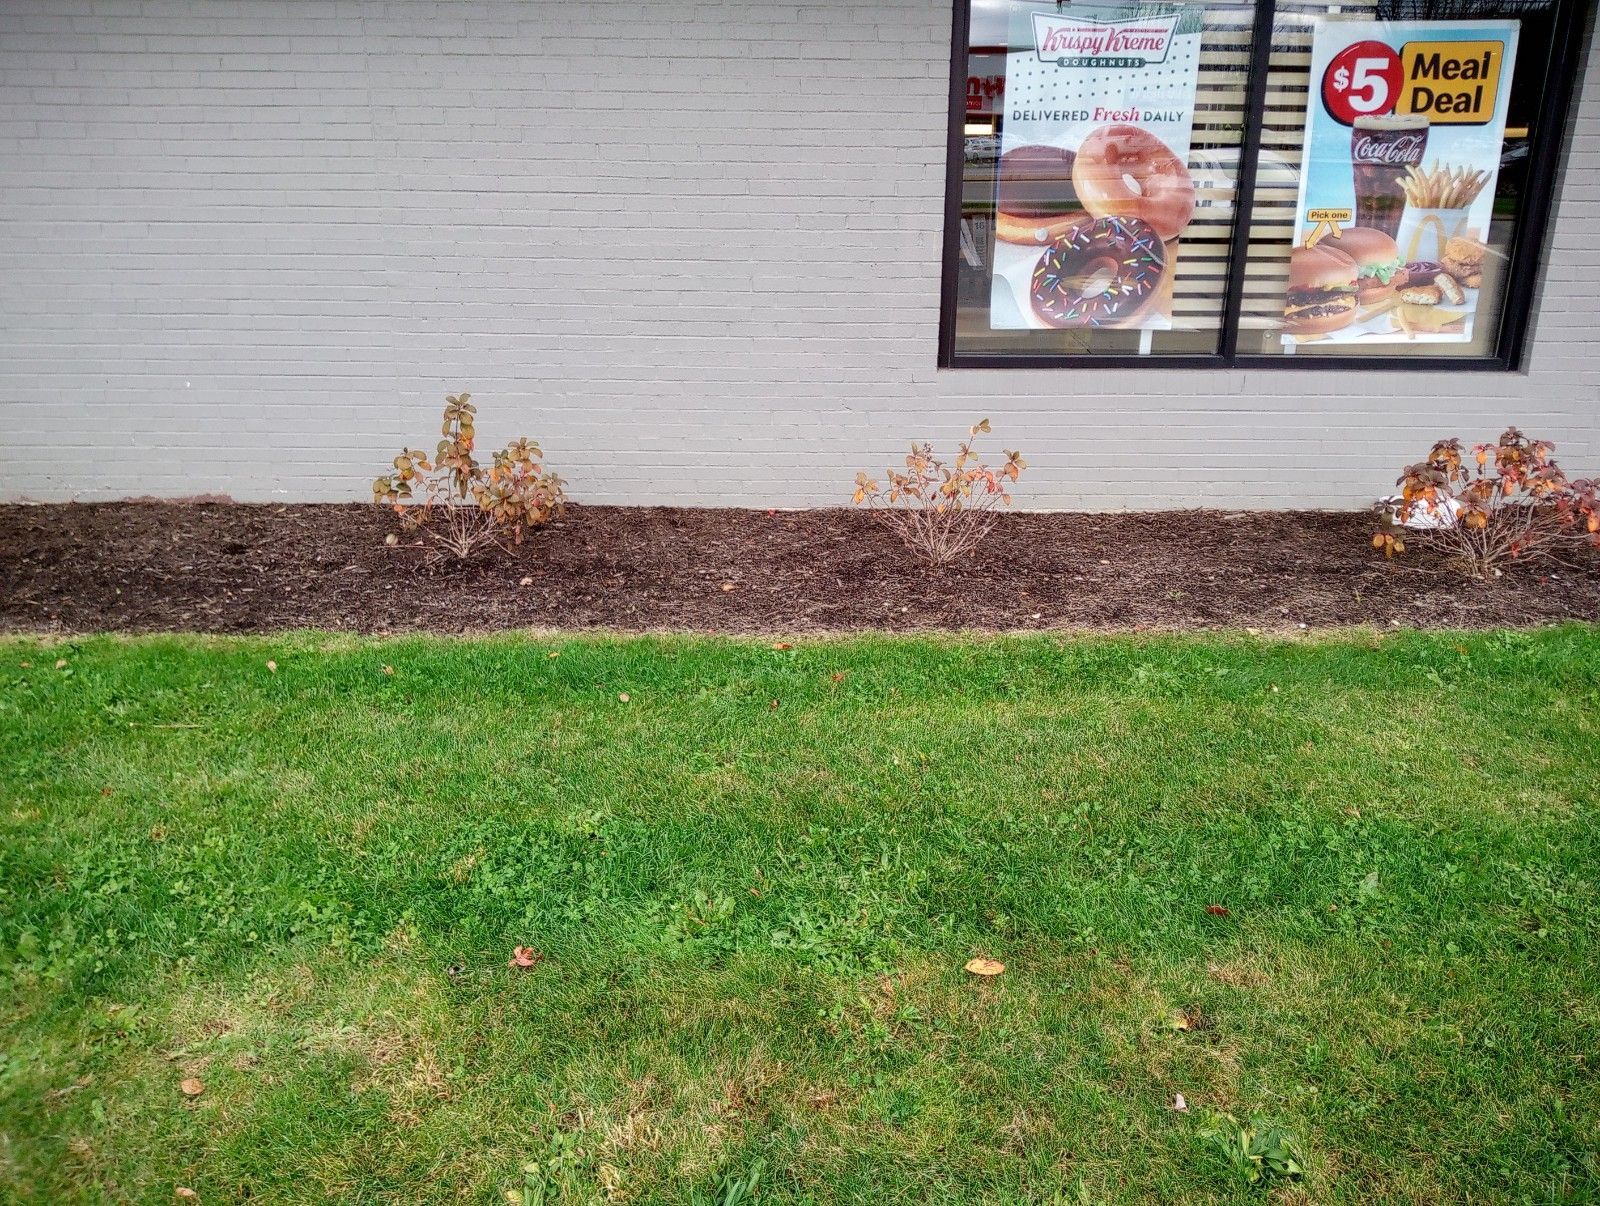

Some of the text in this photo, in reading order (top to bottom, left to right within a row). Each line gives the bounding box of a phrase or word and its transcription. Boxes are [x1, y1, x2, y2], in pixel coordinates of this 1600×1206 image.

[1042, 27, 1168, 55] Krispy Kreme
[1063, 58, 1140, 66] DOUGHNUTS
[1411, 51, 1491, 80] Meal
[1333, 57, 1390, 112] $5
[1411, 85, 1483, 114] Deal
[1012, 107, 1184, 122] DELIVERED Fresh DAILY
[1311, 211, 1329, 219] Pick
